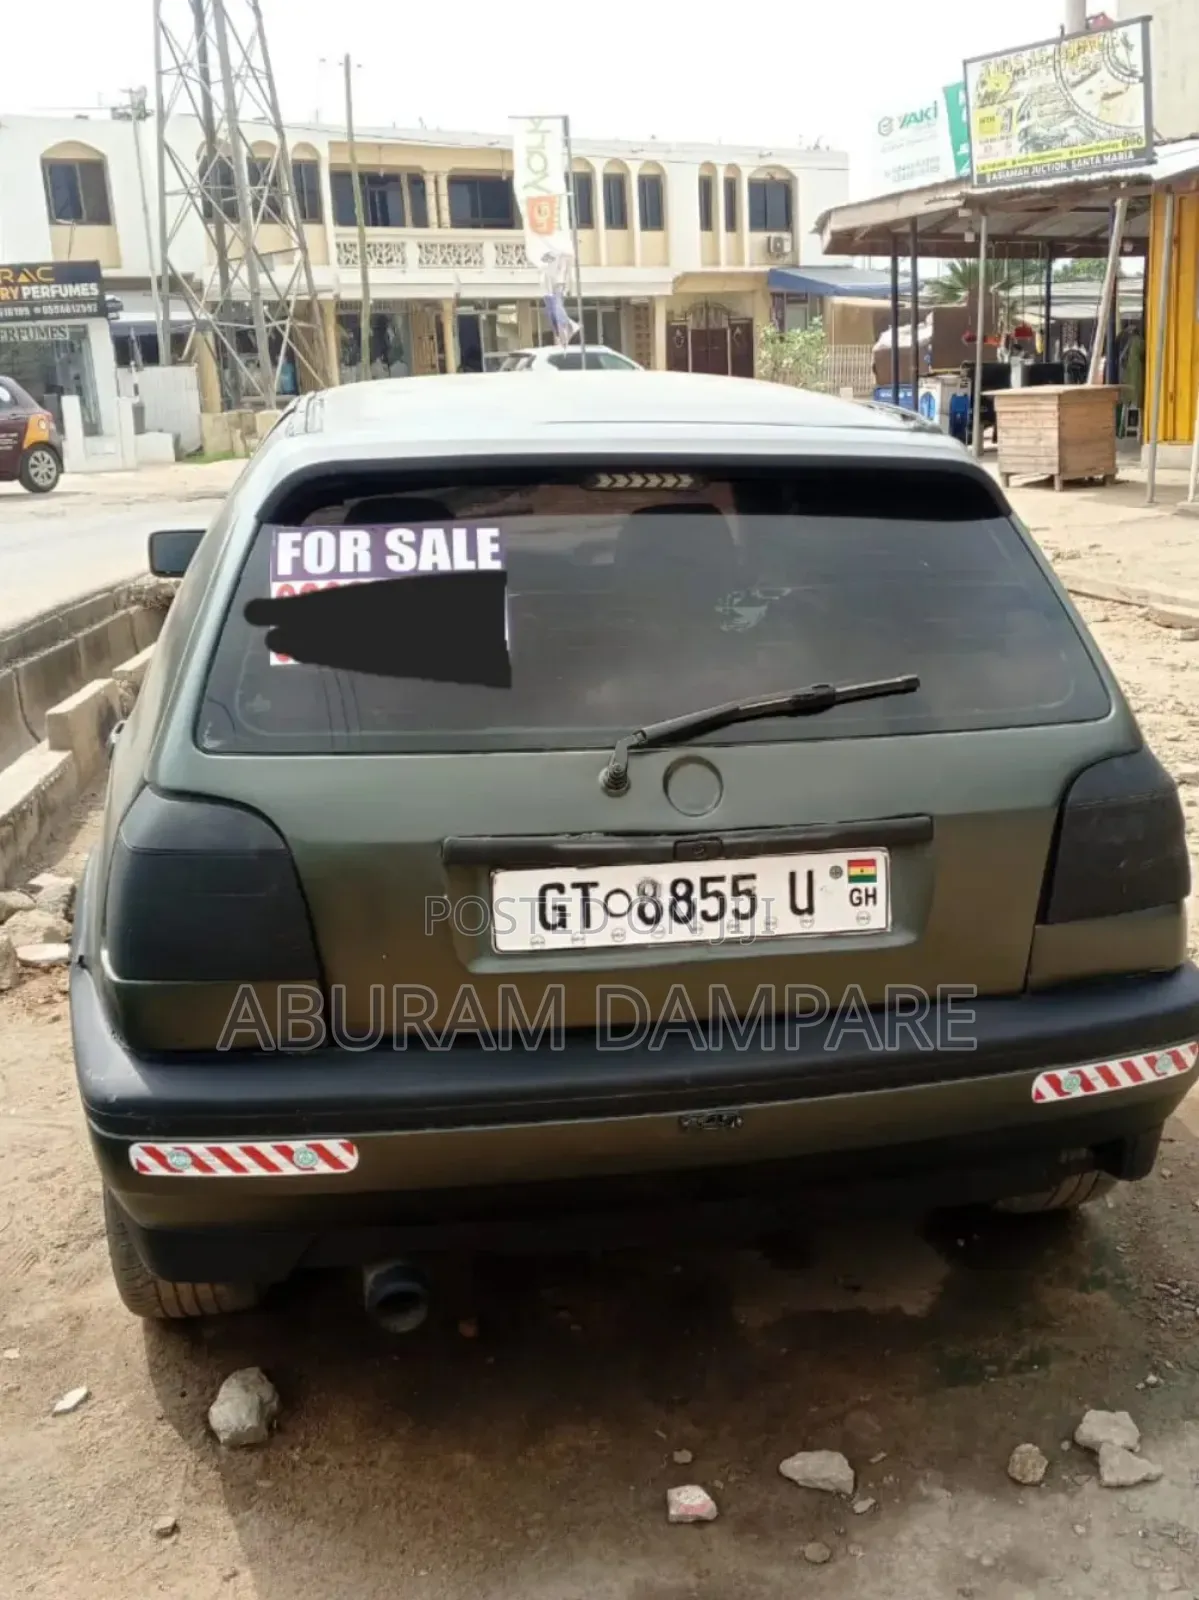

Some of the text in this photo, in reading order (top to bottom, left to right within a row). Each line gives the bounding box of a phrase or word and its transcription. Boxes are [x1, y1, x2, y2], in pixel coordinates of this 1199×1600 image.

[21, 282, 99, 300] PERFUMES
[276, 527, 502, 576] FOR SALE
[538, 869, 815, 931] GT 8855 U
[849, 887, 877, 907] GH
